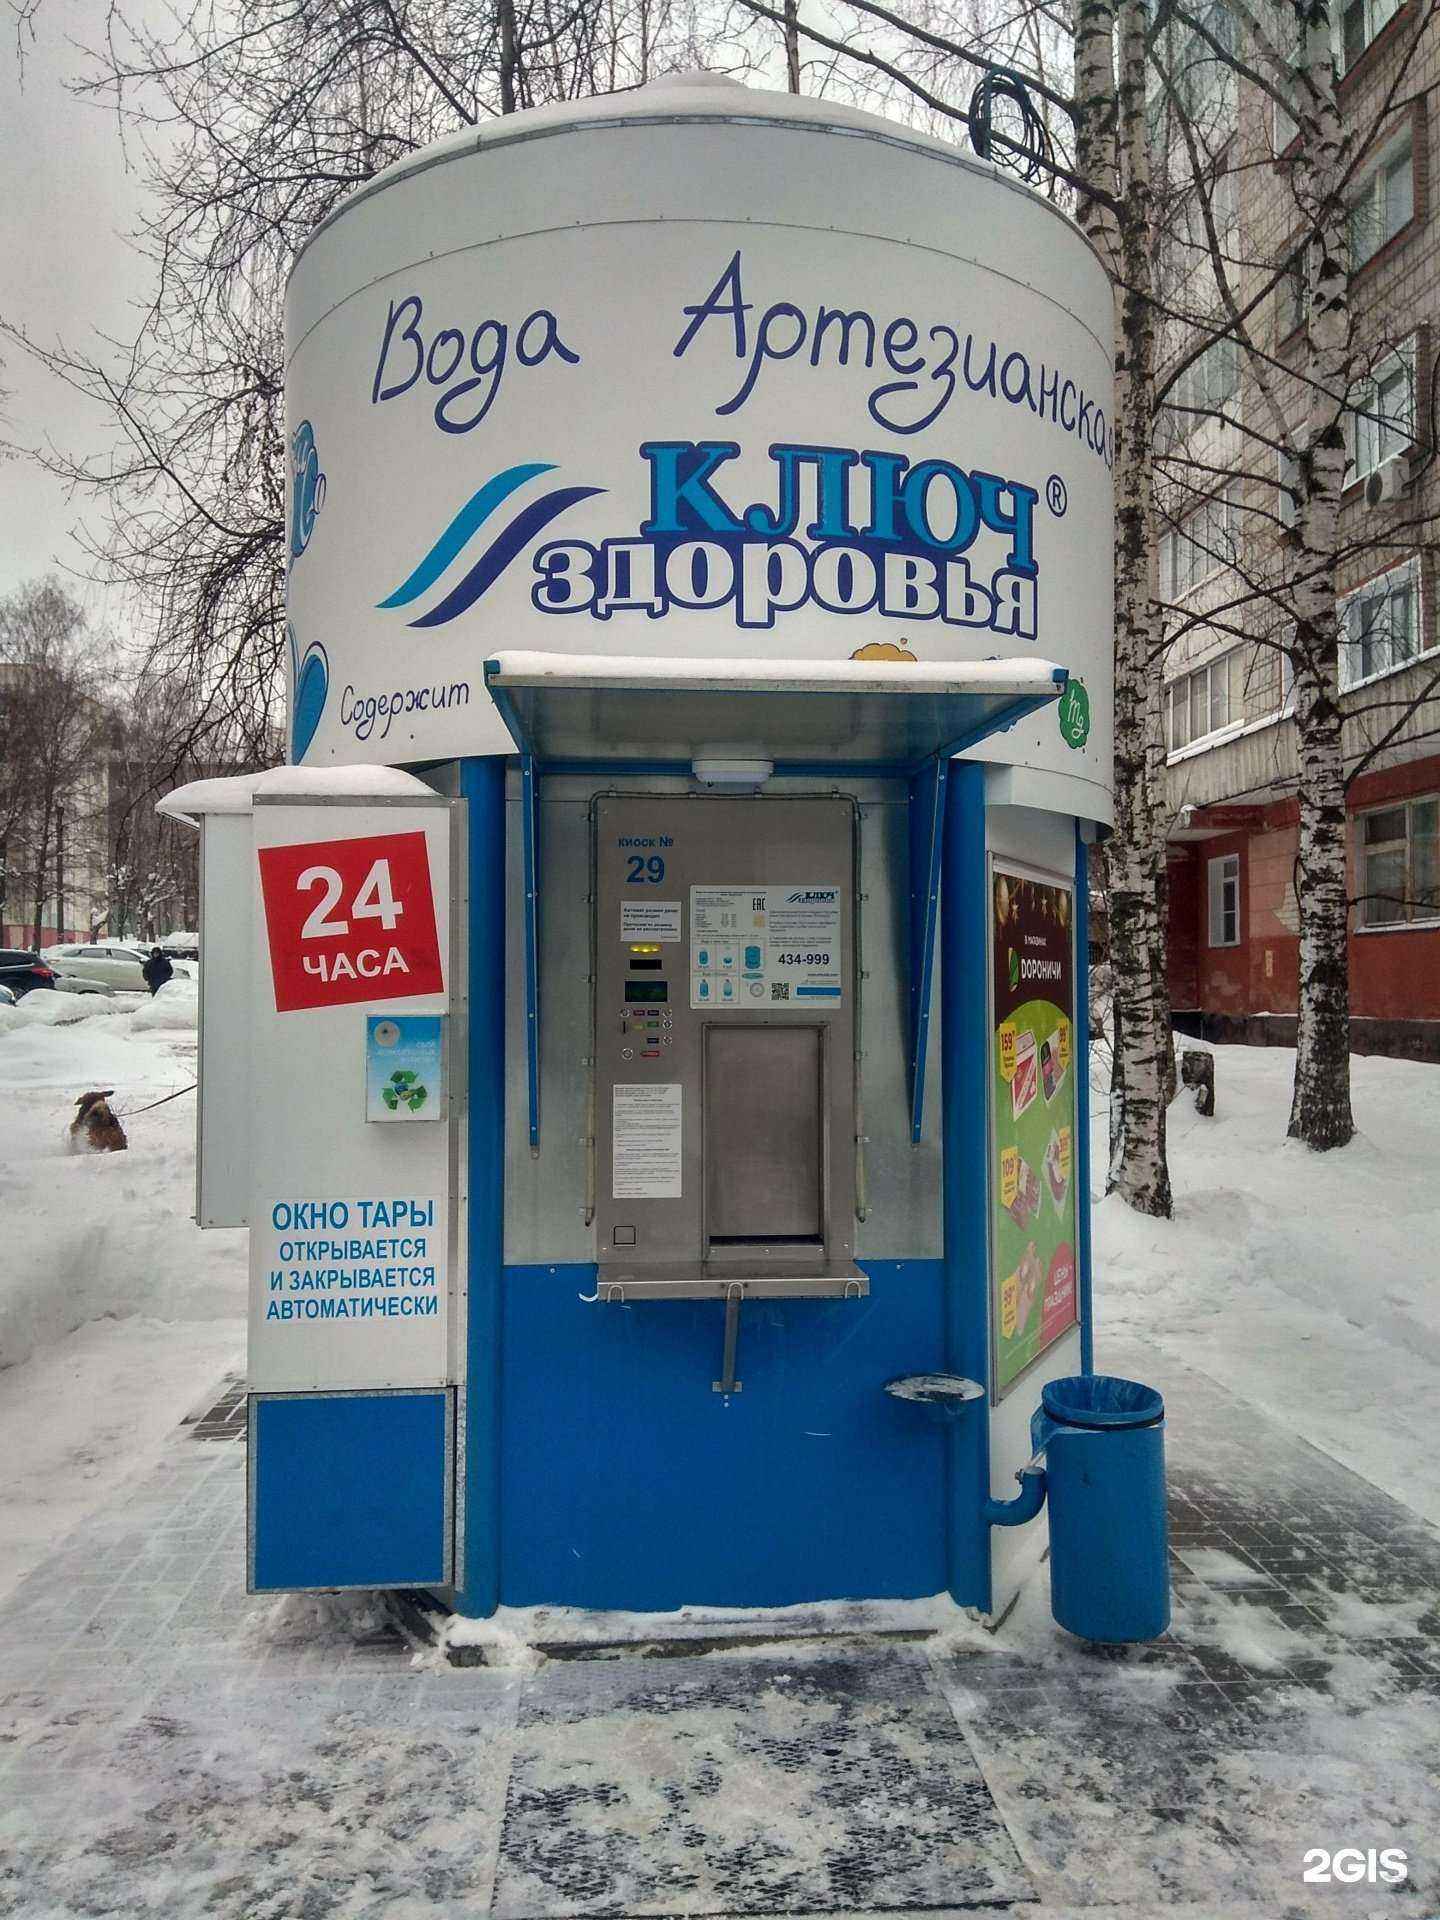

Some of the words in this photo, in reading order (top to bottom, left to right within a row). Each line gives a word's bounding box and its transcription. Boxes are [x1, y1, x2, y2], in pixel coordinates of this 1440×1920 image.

[372, 295, 581, 434] Вода
[640, 441, 1038, 573] КЛЮЧ
[531, 538, 1038, 640] здоровья
[340, 681, 470, 742] Содержит
[659, 836, 674, 848] №
[626, 855, 665, 884] 29
[297, 858, 403, 940] 24
[302, 946, 410, 983] ЧАСА
[778, 953, 830, 966] 434-999
[272, 1201, 349, 1231] ОКНО
[357, 1200, 433, 1228] ТАРЫ
[279, 1238, 426, 1262] ОТКРЫВАЕТСЯ
[270, 1271, 283, 1291] И
[289, 1266, 435, 1291] ЗАКРЫВАЕТСЯ
[266, 1295, 438, 1320] АВТОМАТИЧЕСКИ
